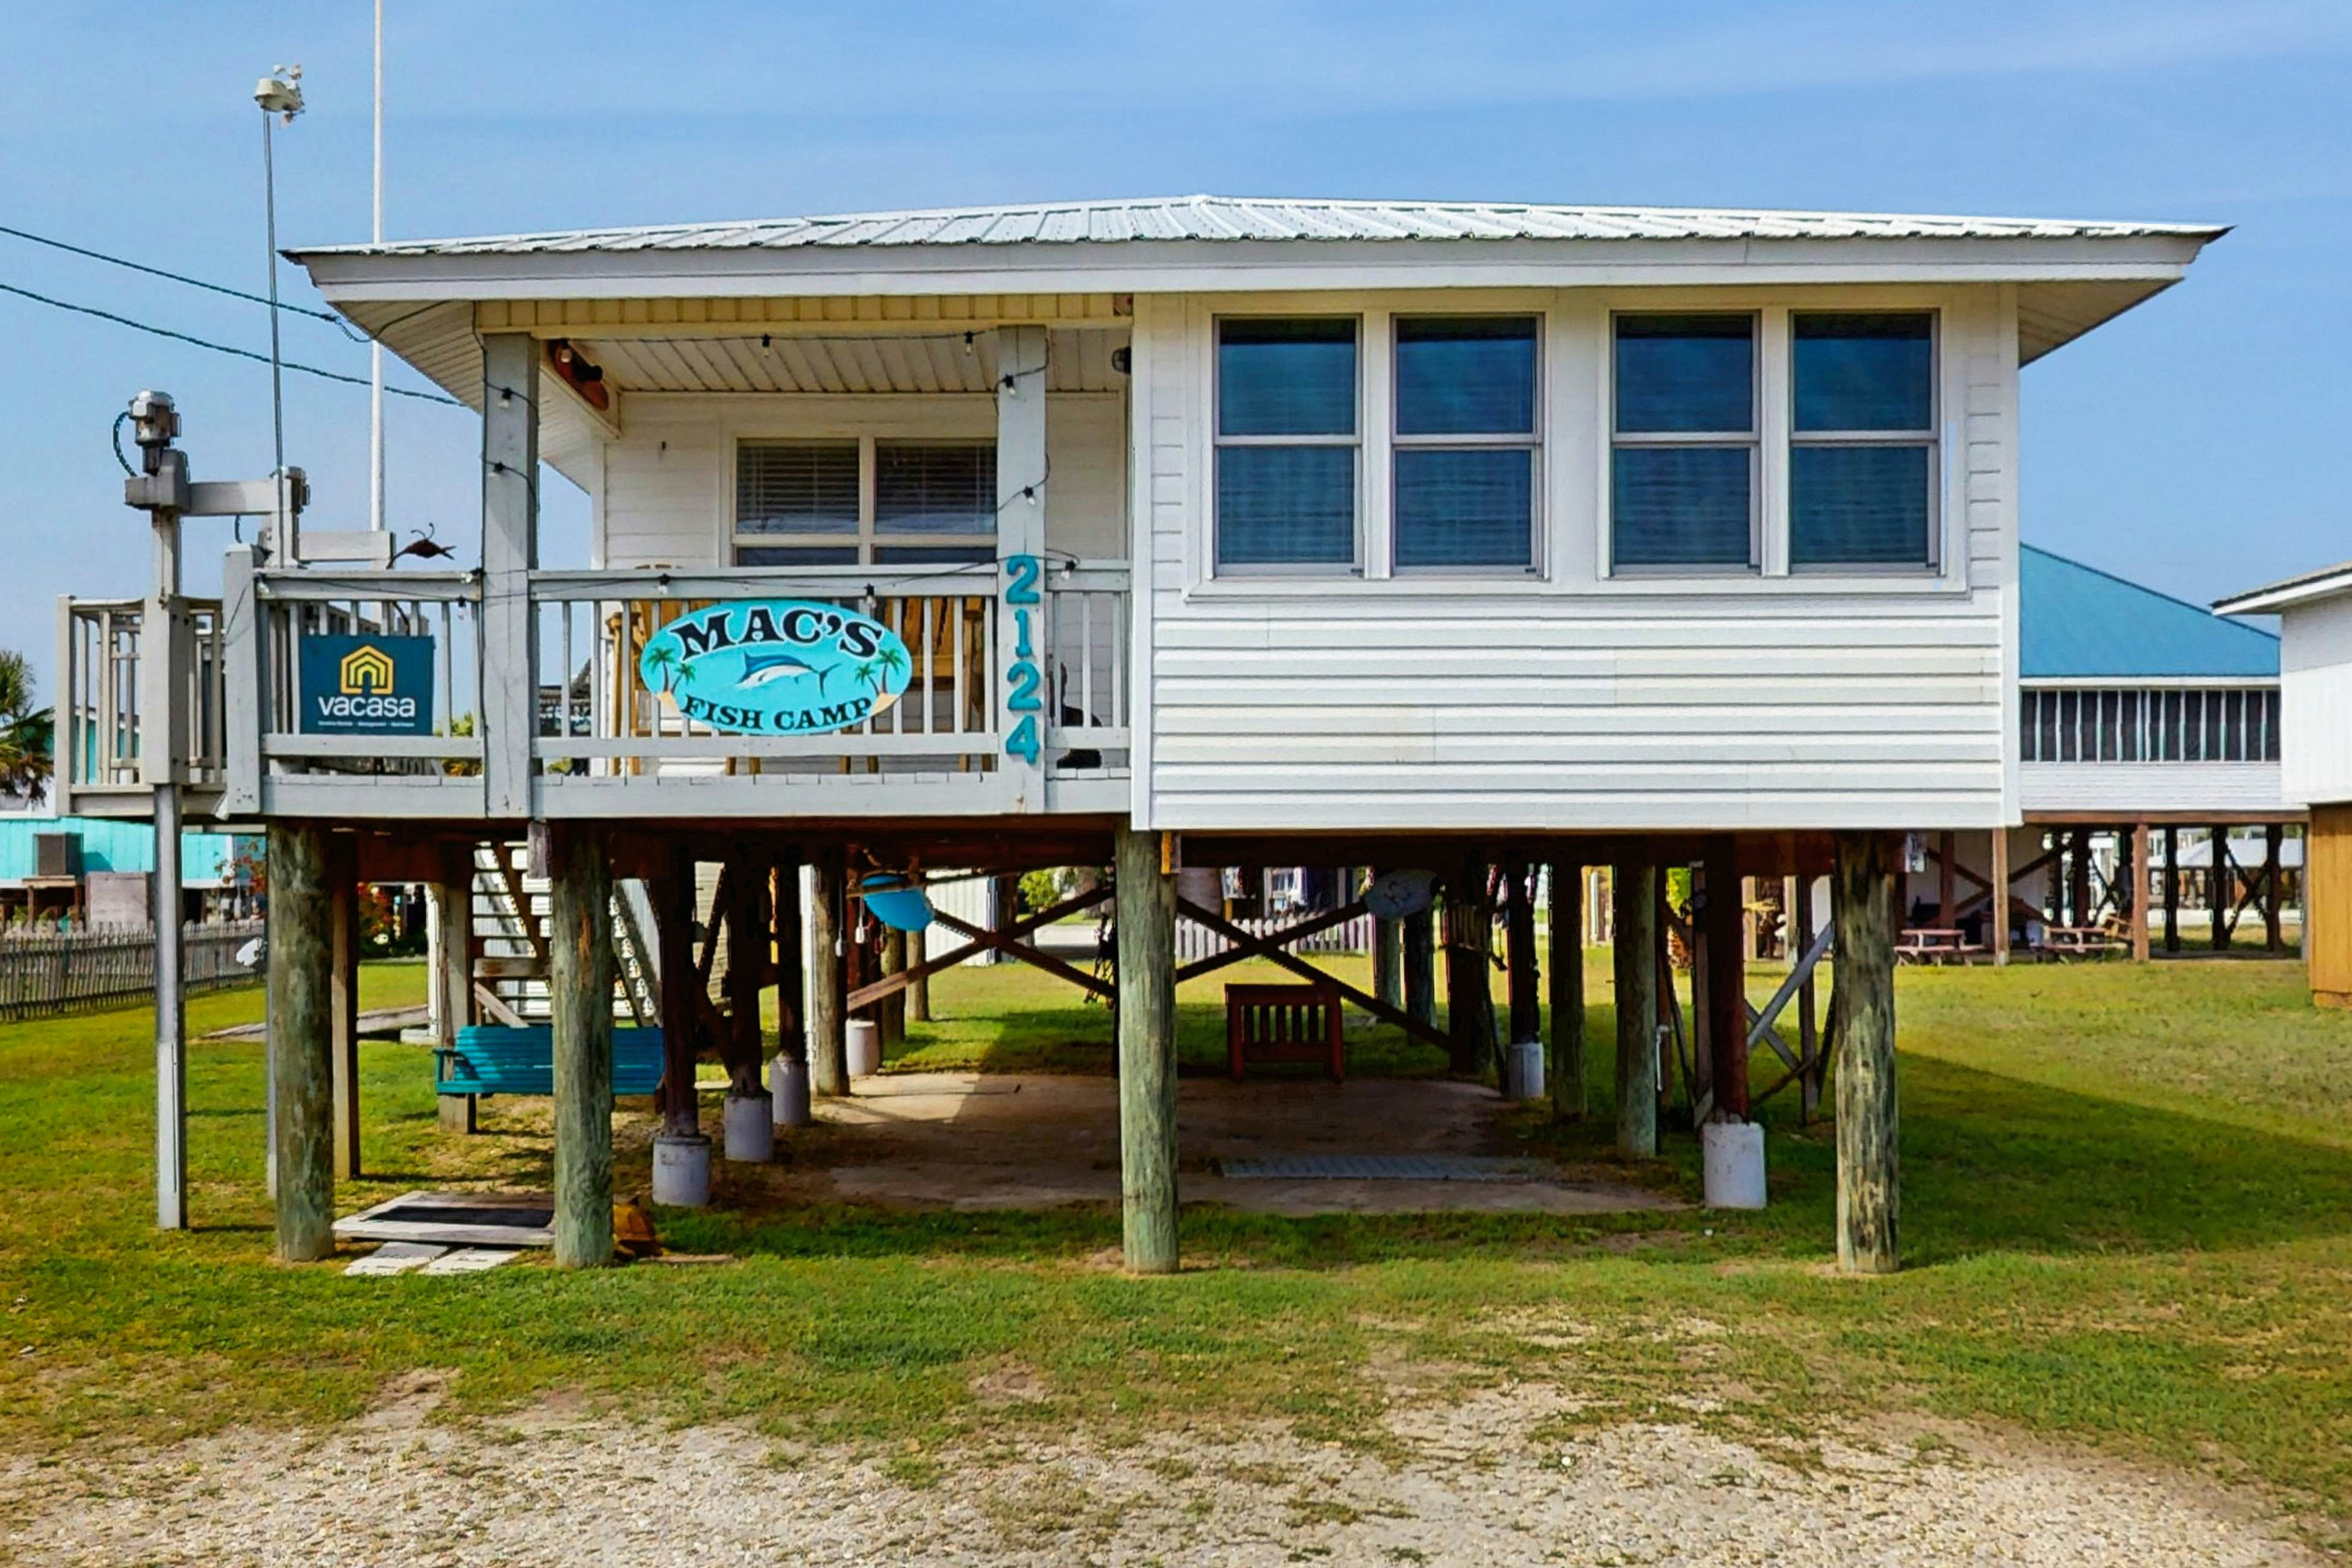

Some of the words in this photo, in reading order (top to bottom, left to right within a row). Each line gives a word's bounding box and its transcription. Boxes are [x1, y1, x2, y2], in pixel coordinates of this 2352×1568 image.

[670, 607, 884, 661] MAC'S
[1006, 554, 1042, 765] 2124
[318, 696, 415, 717] vacasa
[680, 694, 764, 729] FISH
[774, 697, 873, 730] CAMP
